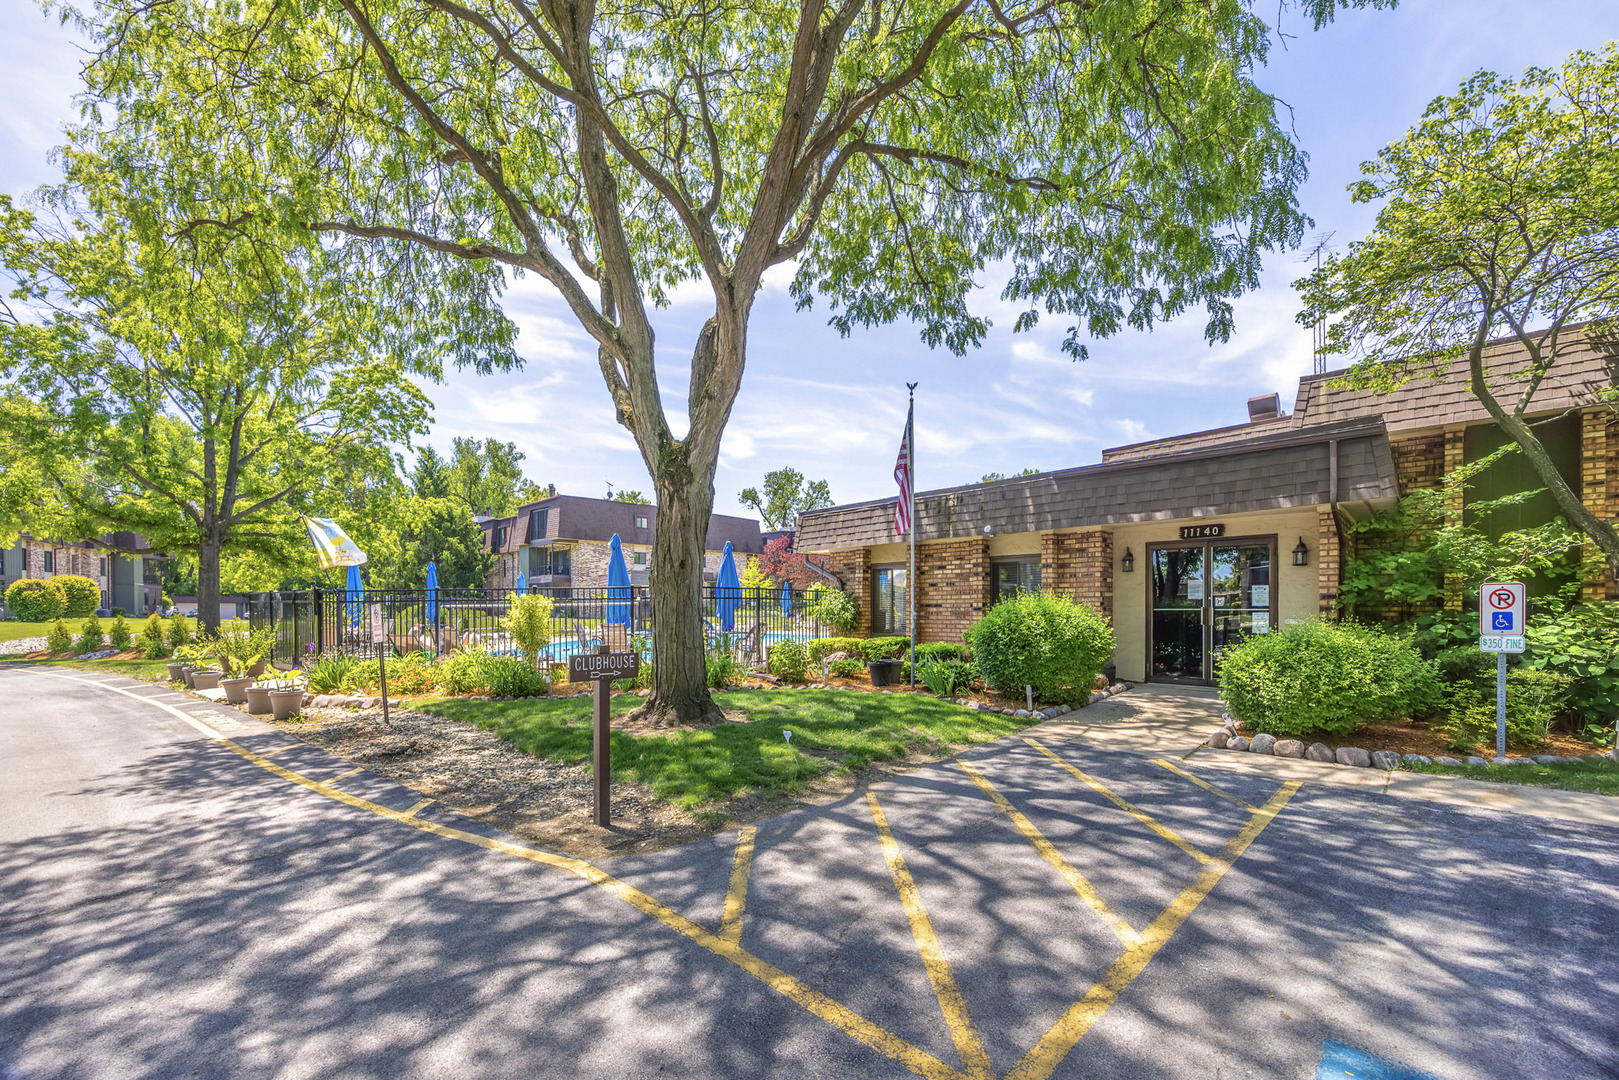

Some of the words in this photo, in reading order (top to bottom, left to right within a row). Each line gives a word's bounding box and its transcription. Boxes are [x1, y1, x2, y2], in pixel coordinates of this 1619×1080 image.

[1184, 526, 1219, 538] 11140
[1497, 593, 1511, 606] P
[1482, 638, 1503, 649] $350
[1506, 638, 1523, 649] FINE
[574, 654, 635, 671] CLUBHOUSE
